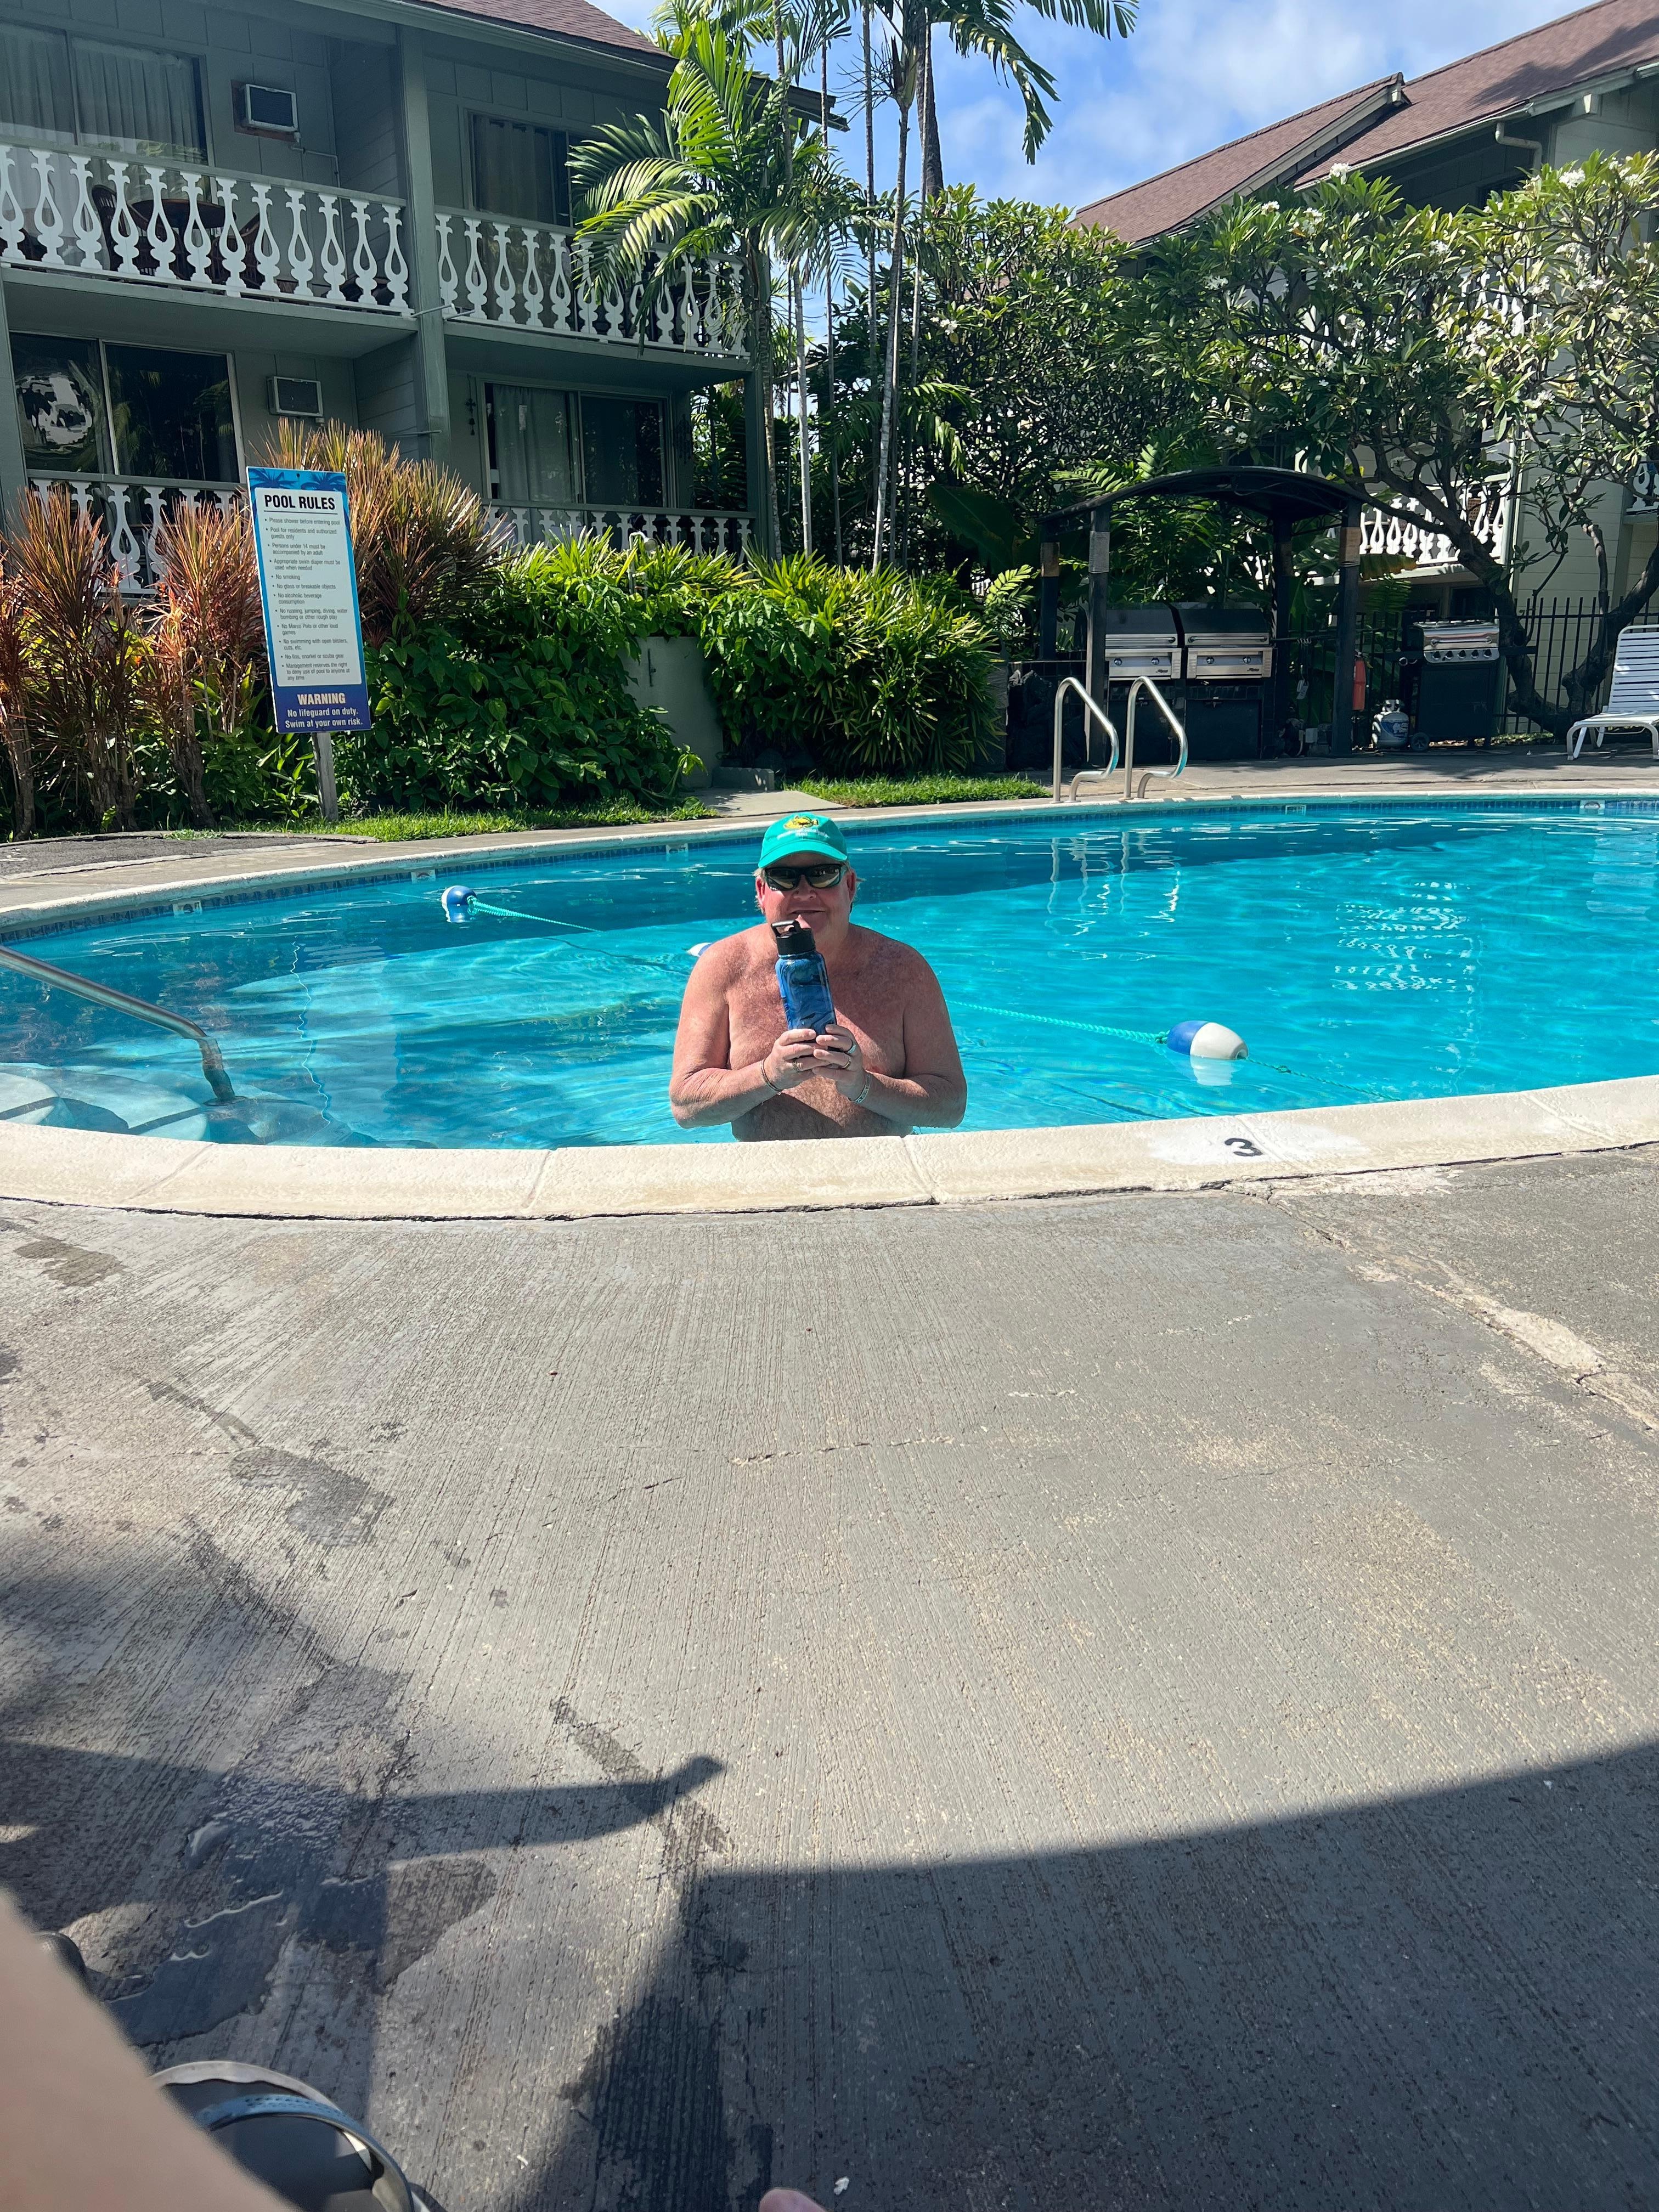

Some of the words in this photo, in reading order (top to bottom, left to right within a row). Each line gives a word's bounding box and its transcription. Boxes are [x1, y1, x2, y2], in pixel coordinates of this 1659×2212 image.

[264, 495, 296, 508] POOL
[298, 496, 335, 510] RULES
[297, 693, 346, 705] WARNING
[299, 708, 330, 718] lifeguard
[342, 708, 358, 716] duty.
[315, 720, 330, 728] your
[1224, 1138, 1263, 1156] 3
